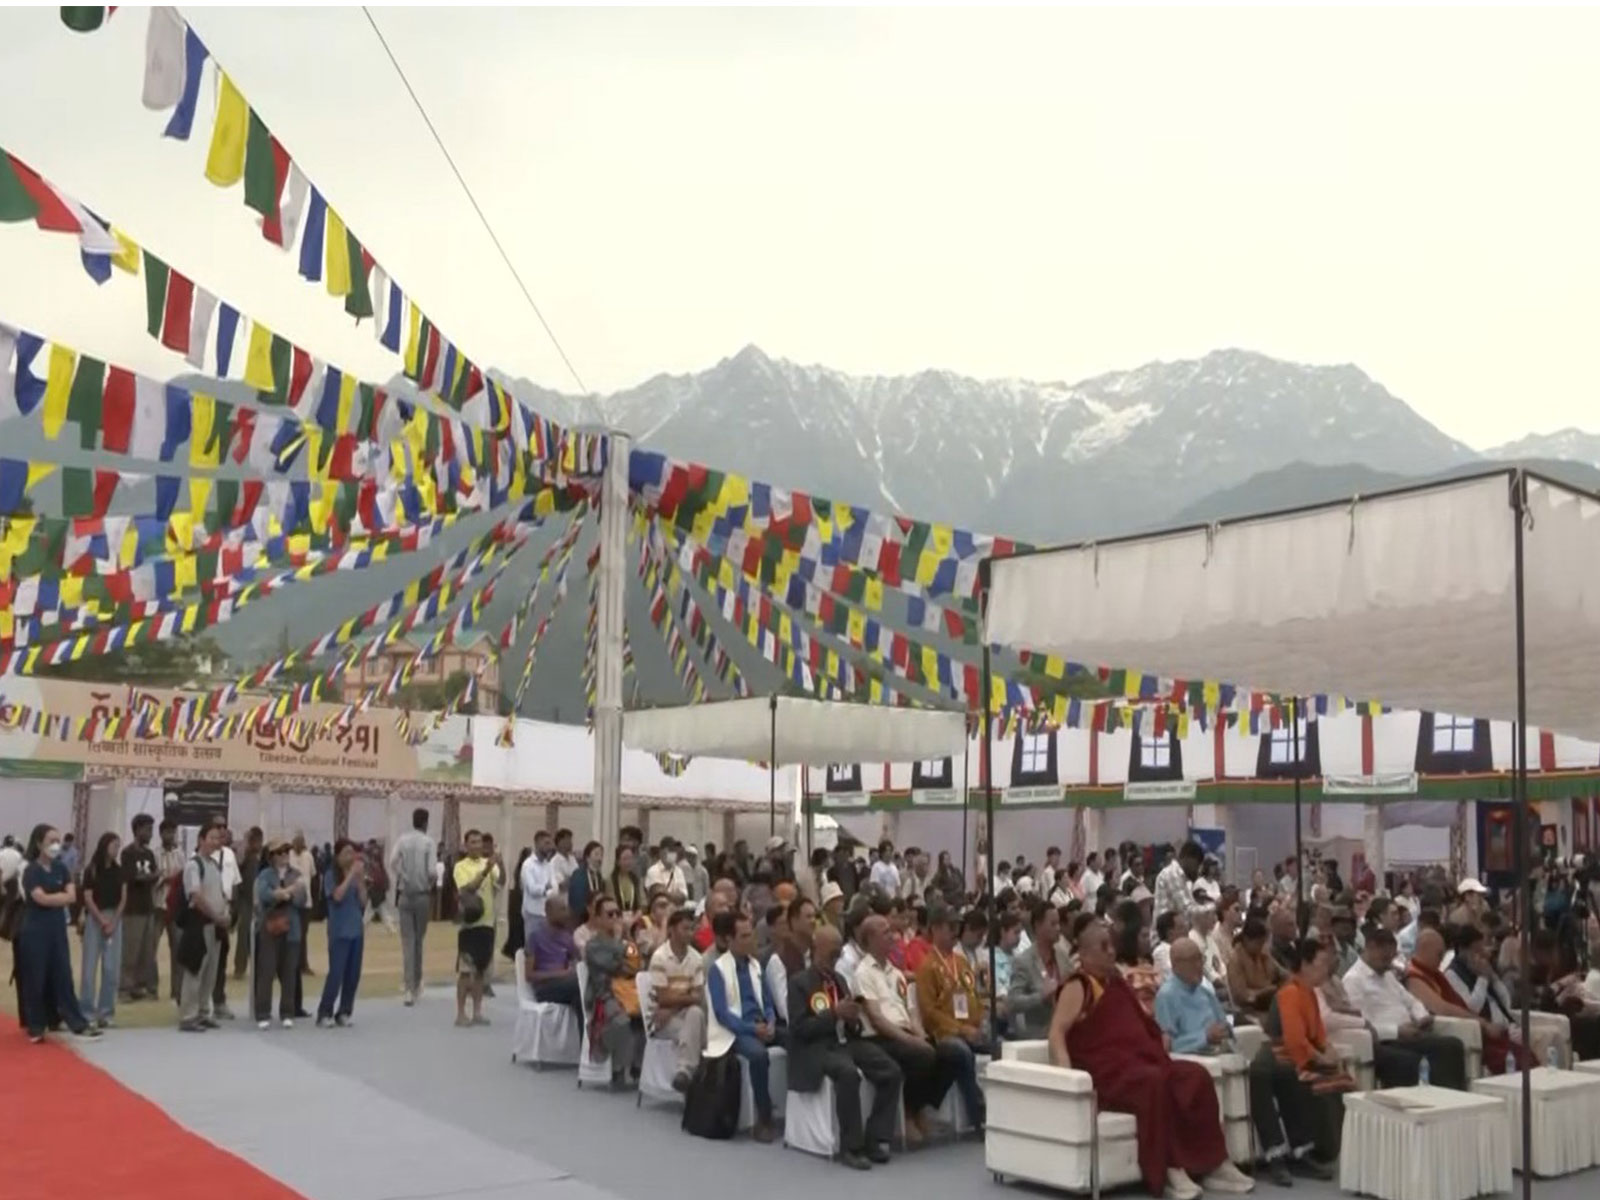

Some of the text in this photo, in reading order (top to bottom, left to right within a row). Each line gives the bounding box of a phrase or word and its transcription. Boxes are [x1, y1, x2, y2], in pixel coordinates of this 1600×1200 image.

[259, 752, 378, 769] Tibetan Cultural Festival
